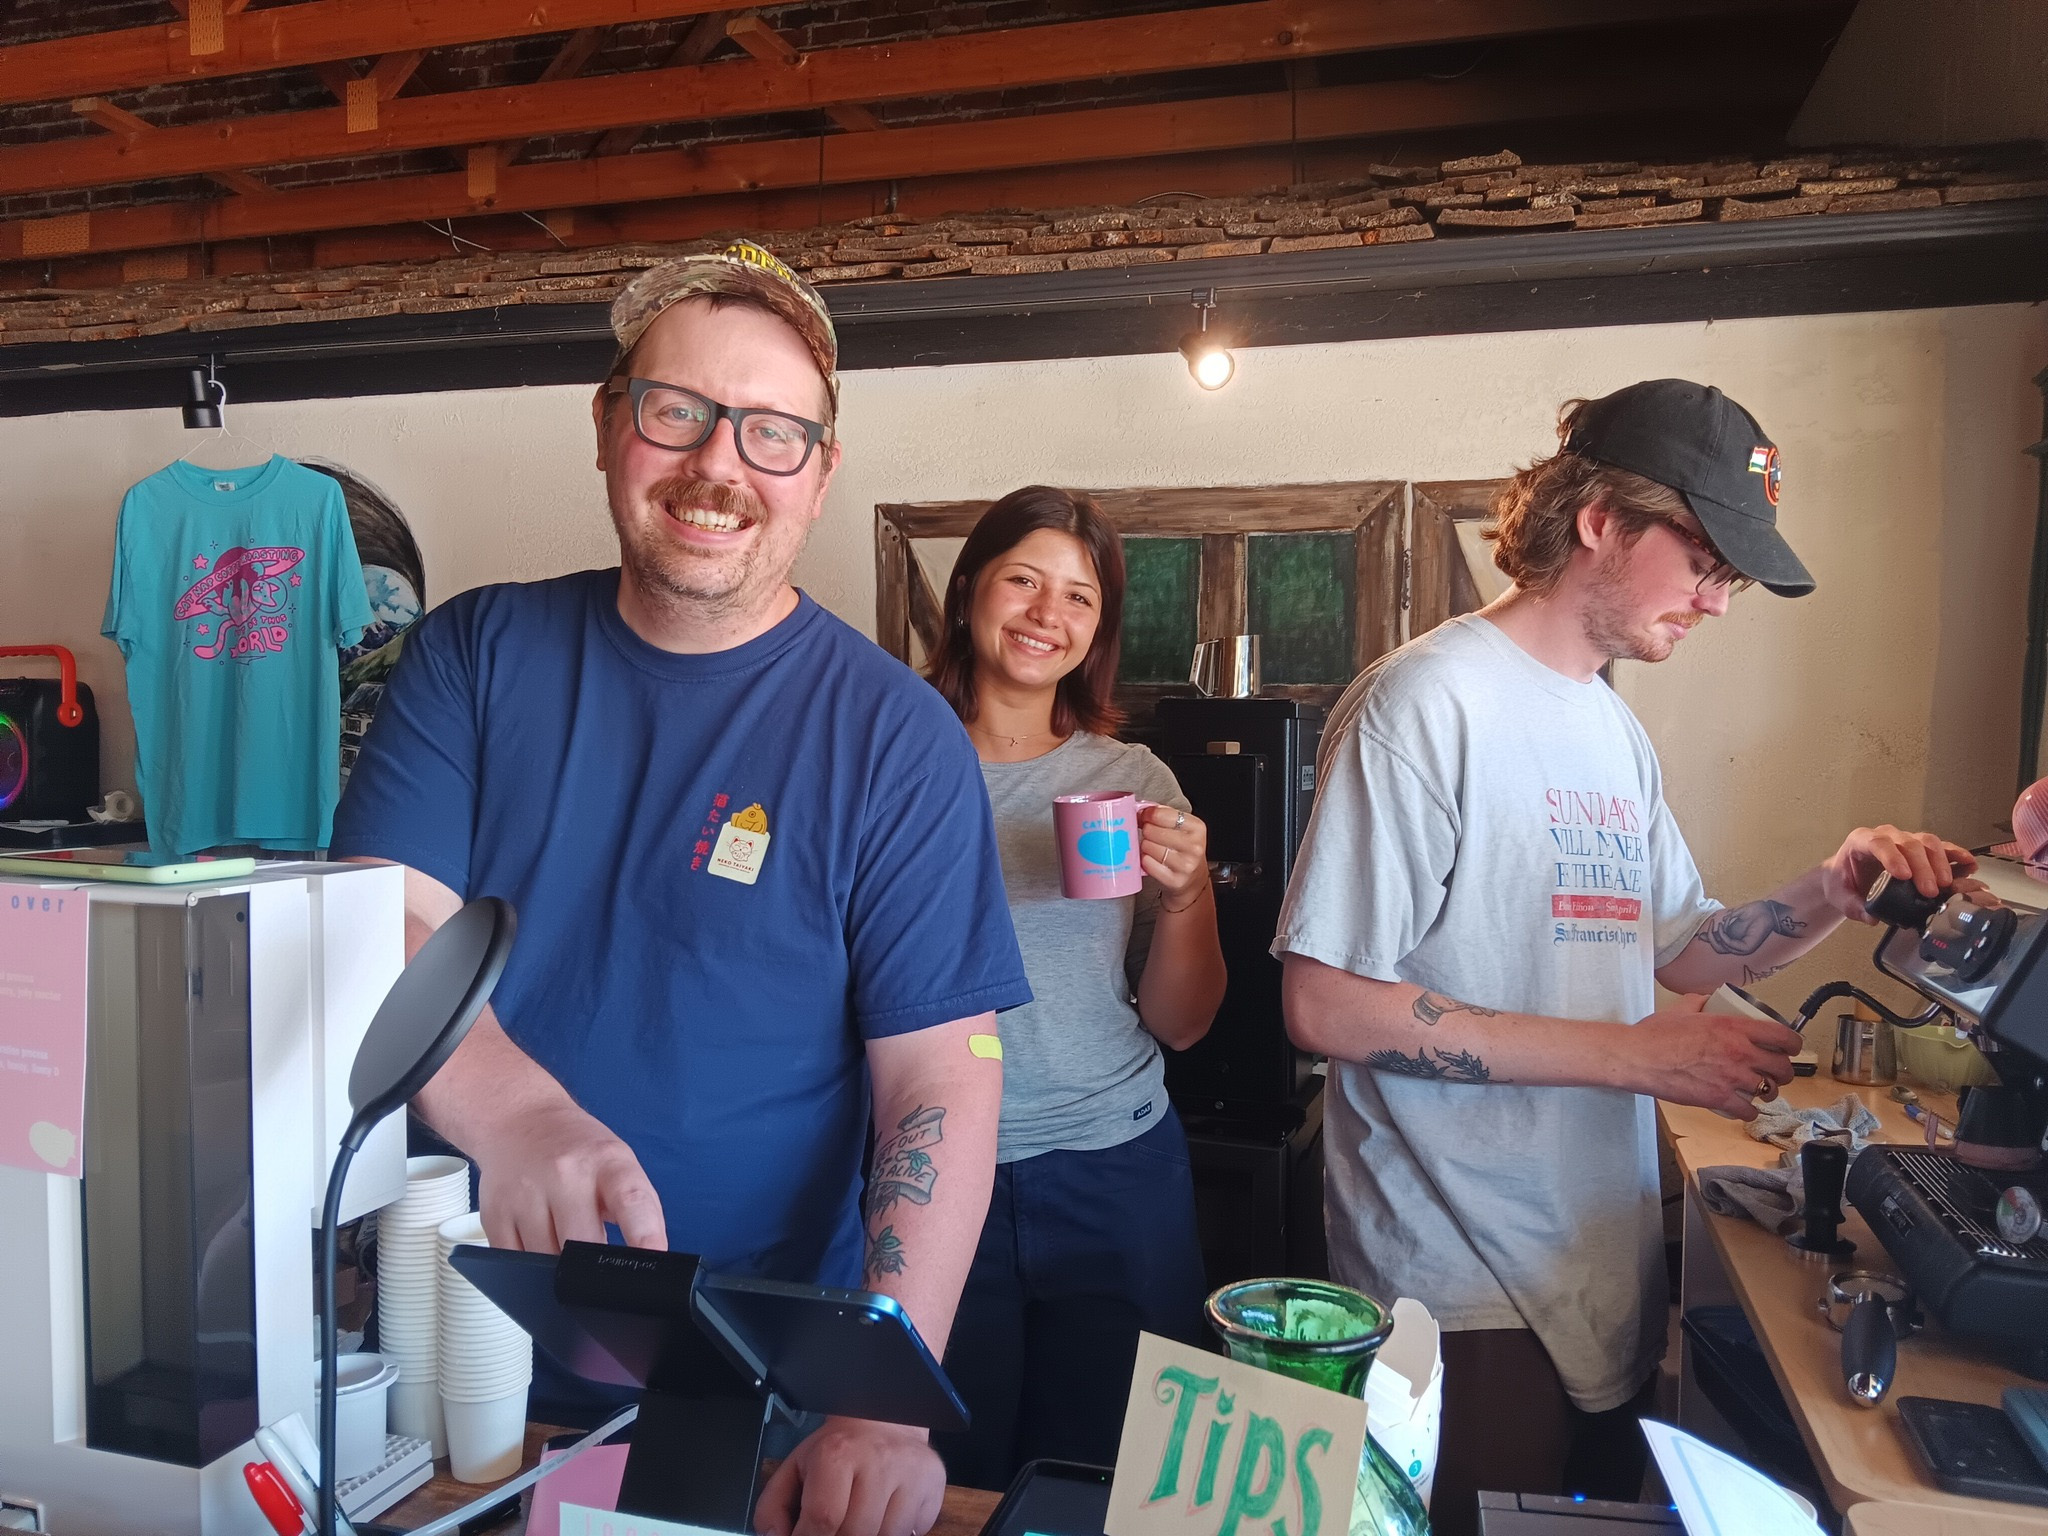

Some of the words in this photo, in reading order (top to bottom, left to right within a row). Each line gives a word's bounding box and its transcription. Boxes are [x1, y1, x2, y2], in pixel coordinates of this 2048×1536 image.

[175, 592, 196, 618] CAT
[193, 577, 215, 599] NAP
[247, 616, 258, 630] OF
[260, 613, 288, 624] THIS
[1545, 787, 1640, 833] SUNDAYS
[11, 895, 64, 913] over
[898, 1128, 931, 1149] OUT
[886, 1164, 932, 1183] ALIVE
[1140, 1365, 1334, 1536] Tips
